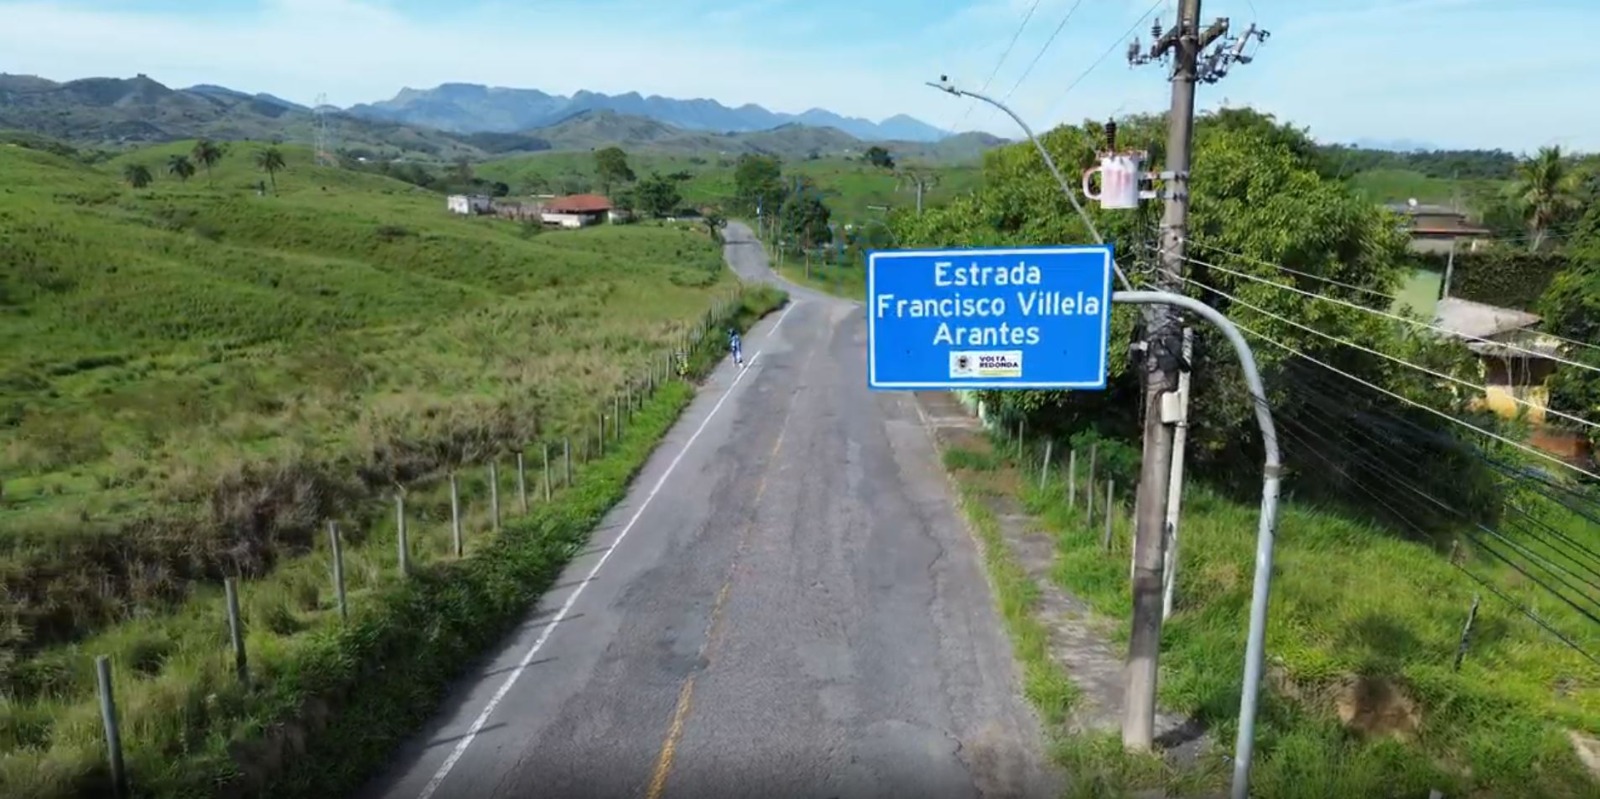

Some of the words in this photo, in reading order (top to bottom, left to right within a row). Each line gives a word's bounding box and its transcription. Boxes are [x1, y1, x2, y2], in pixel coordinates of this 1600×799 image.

[934, 260, 1041, 287] Estrada
[877, 293, 1006, 319] Francisco
[1017, 290, 1100, 317] Villela
[932, 322, 1041, 347] Arantes
